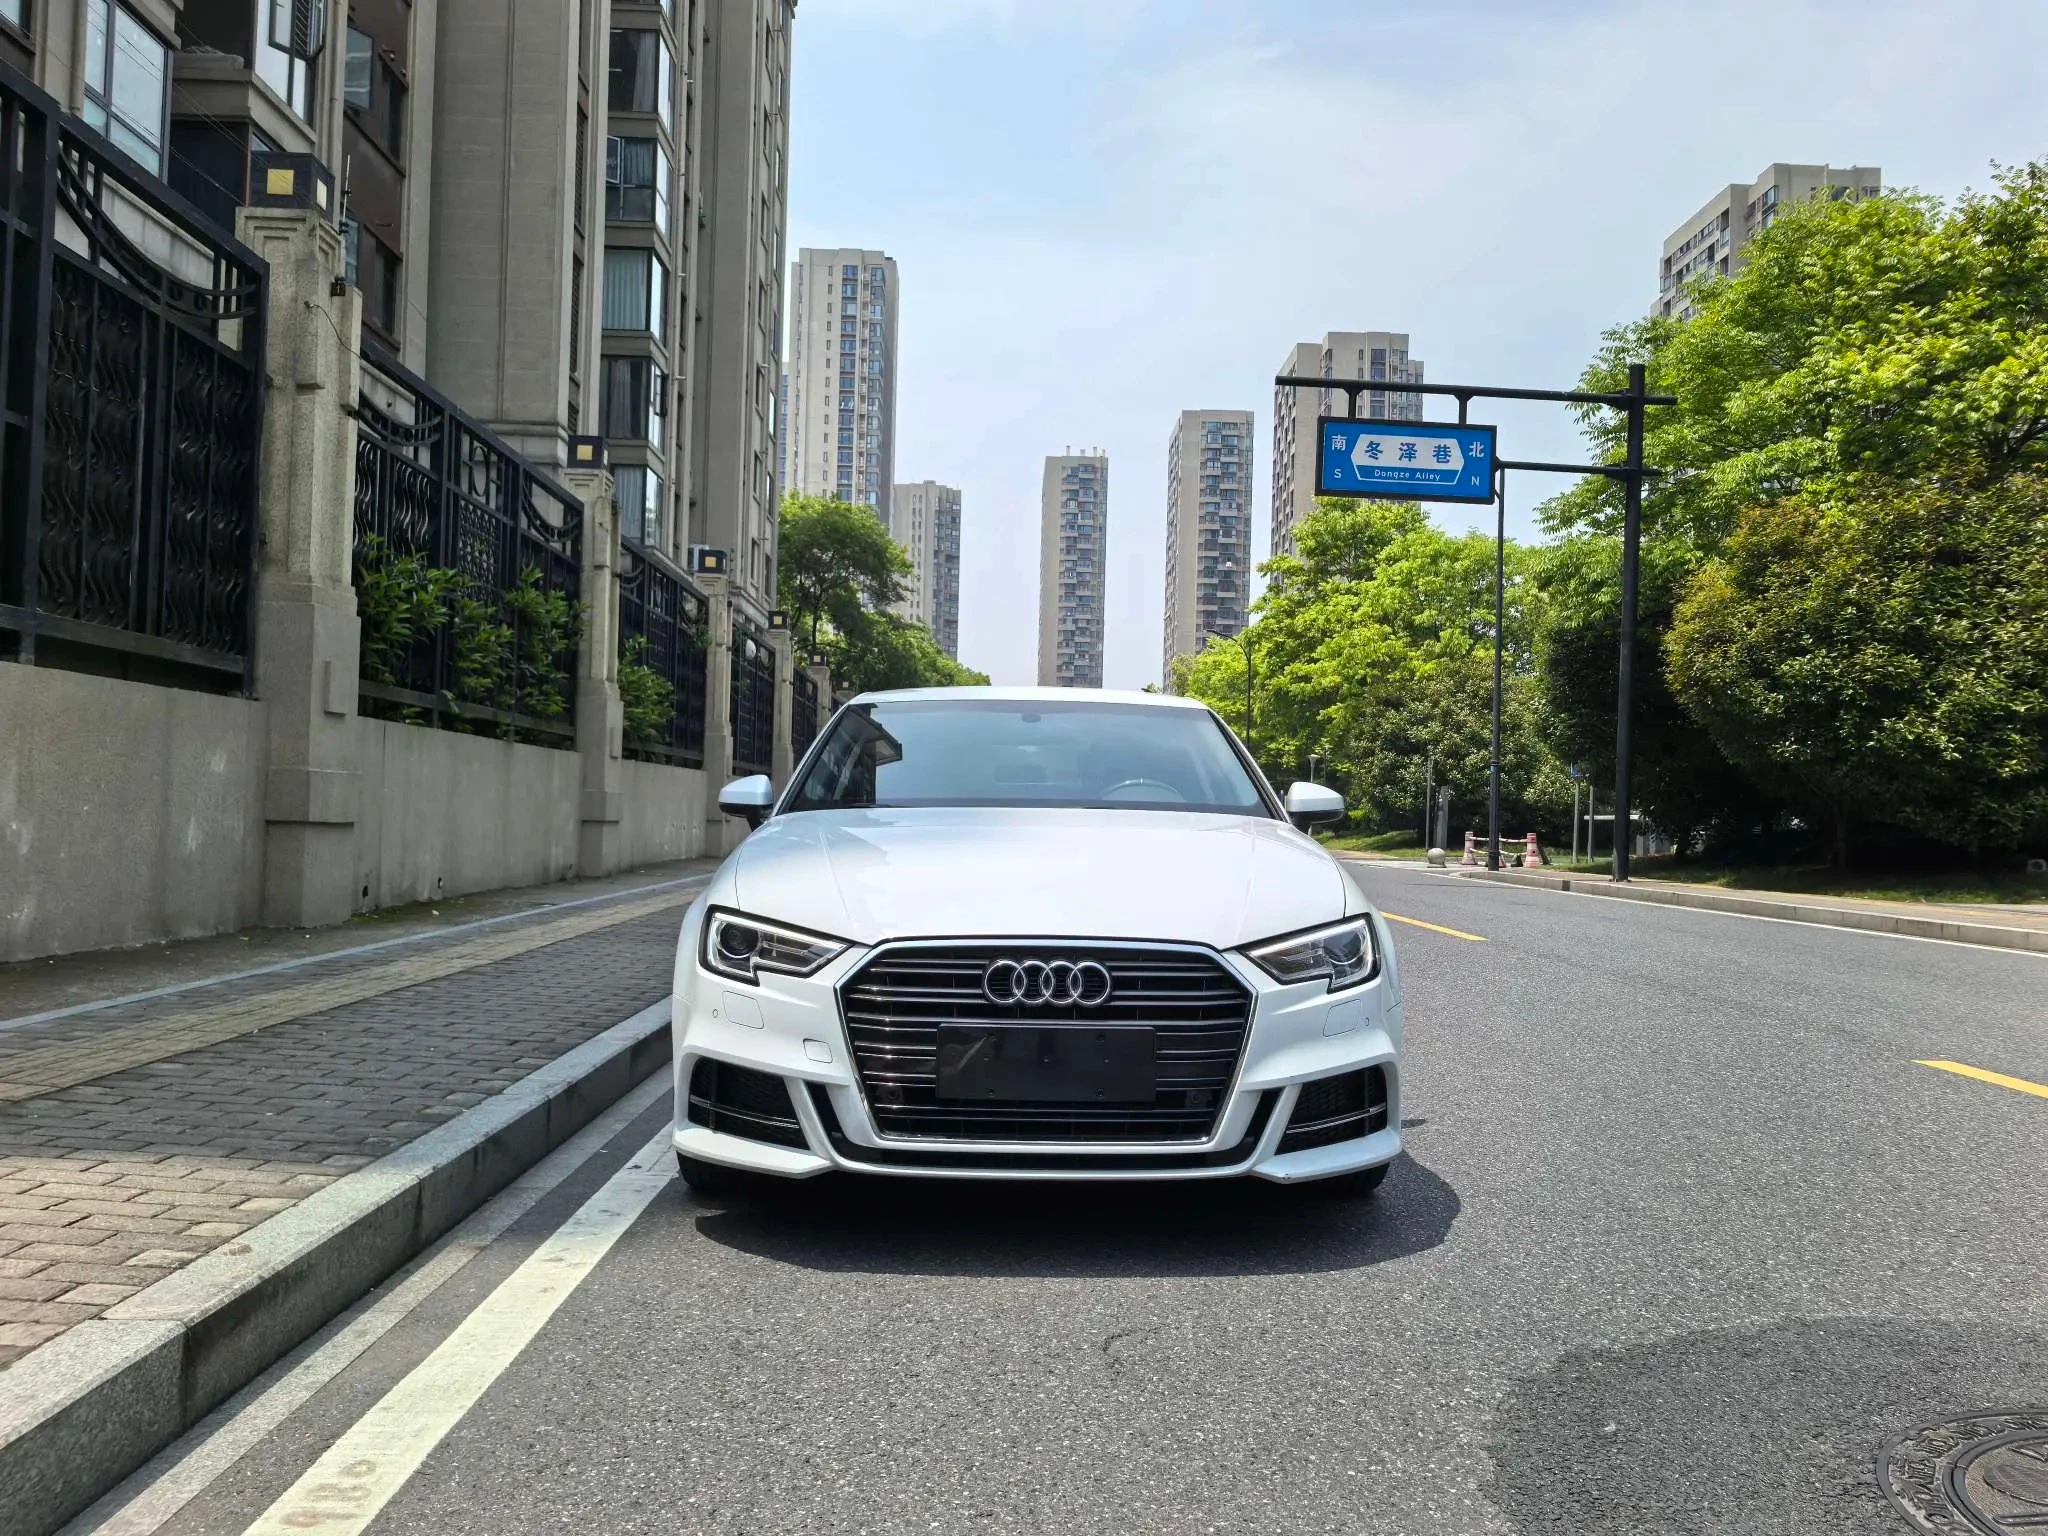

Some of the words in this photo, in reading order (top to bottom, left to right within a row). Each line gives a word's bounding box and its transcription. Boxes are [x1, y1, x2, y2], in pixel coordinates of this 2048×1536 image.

[1331, 434, 1348, 452] 南
[1468, 441, 1485, 458] 北
[1364, 440, 1452, 464] 冬泽巷
[1334, 468, 1342, 479] S
[1374, 469, 1410, 480] Dongze
[1415, 471, 1441, 482] Alley
[1471, 475, 1480, 487] N
